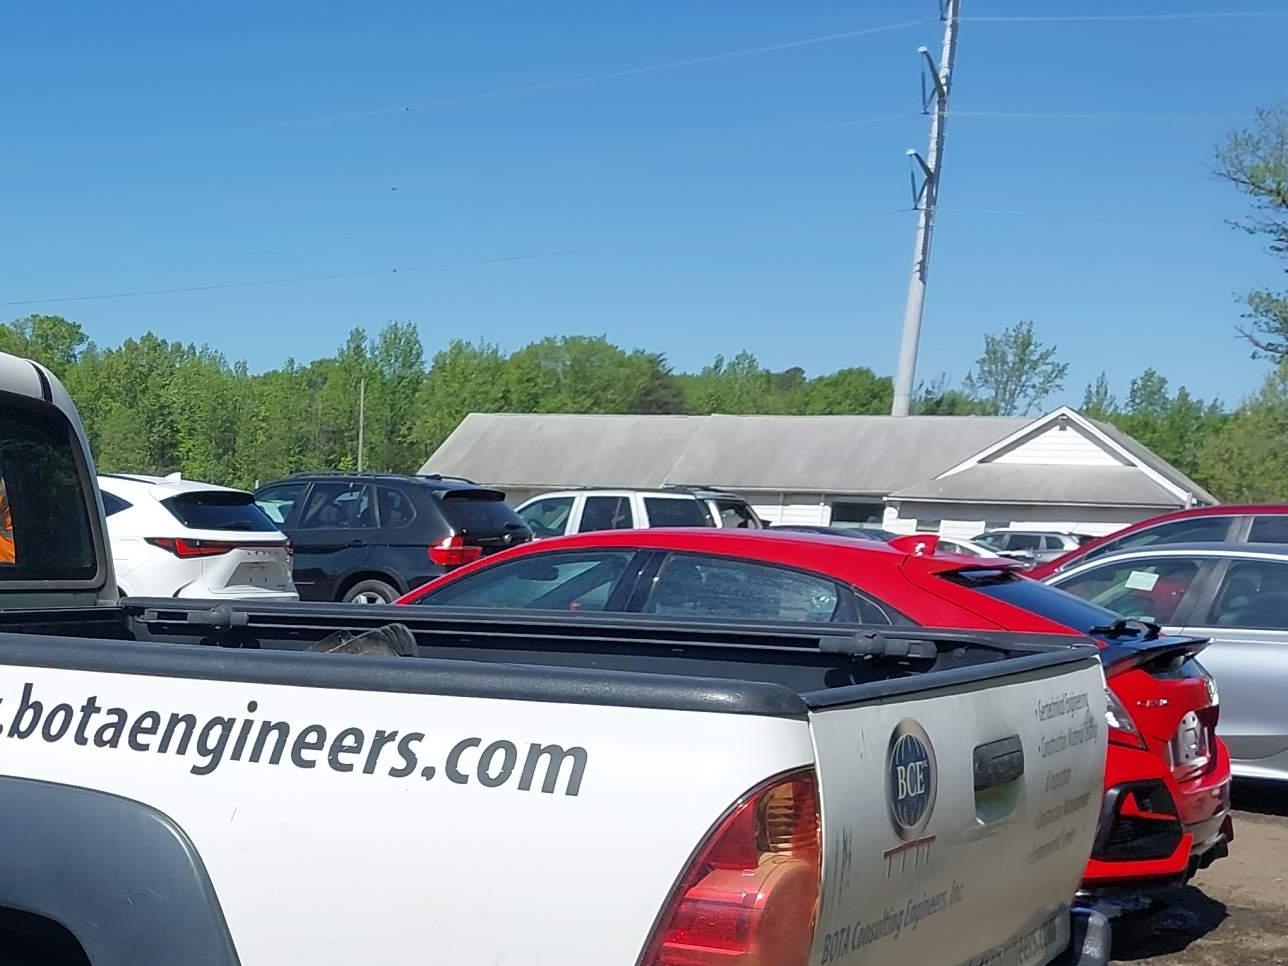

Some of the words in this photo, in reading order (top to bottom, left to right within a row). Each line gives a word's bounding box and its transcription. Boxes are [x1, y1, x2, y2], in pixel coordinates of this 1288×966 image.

[896, 761, 925, 800] BCE
[821, 925, 850, 966] BOTA
[851, 907, 904, 951] Consulting
